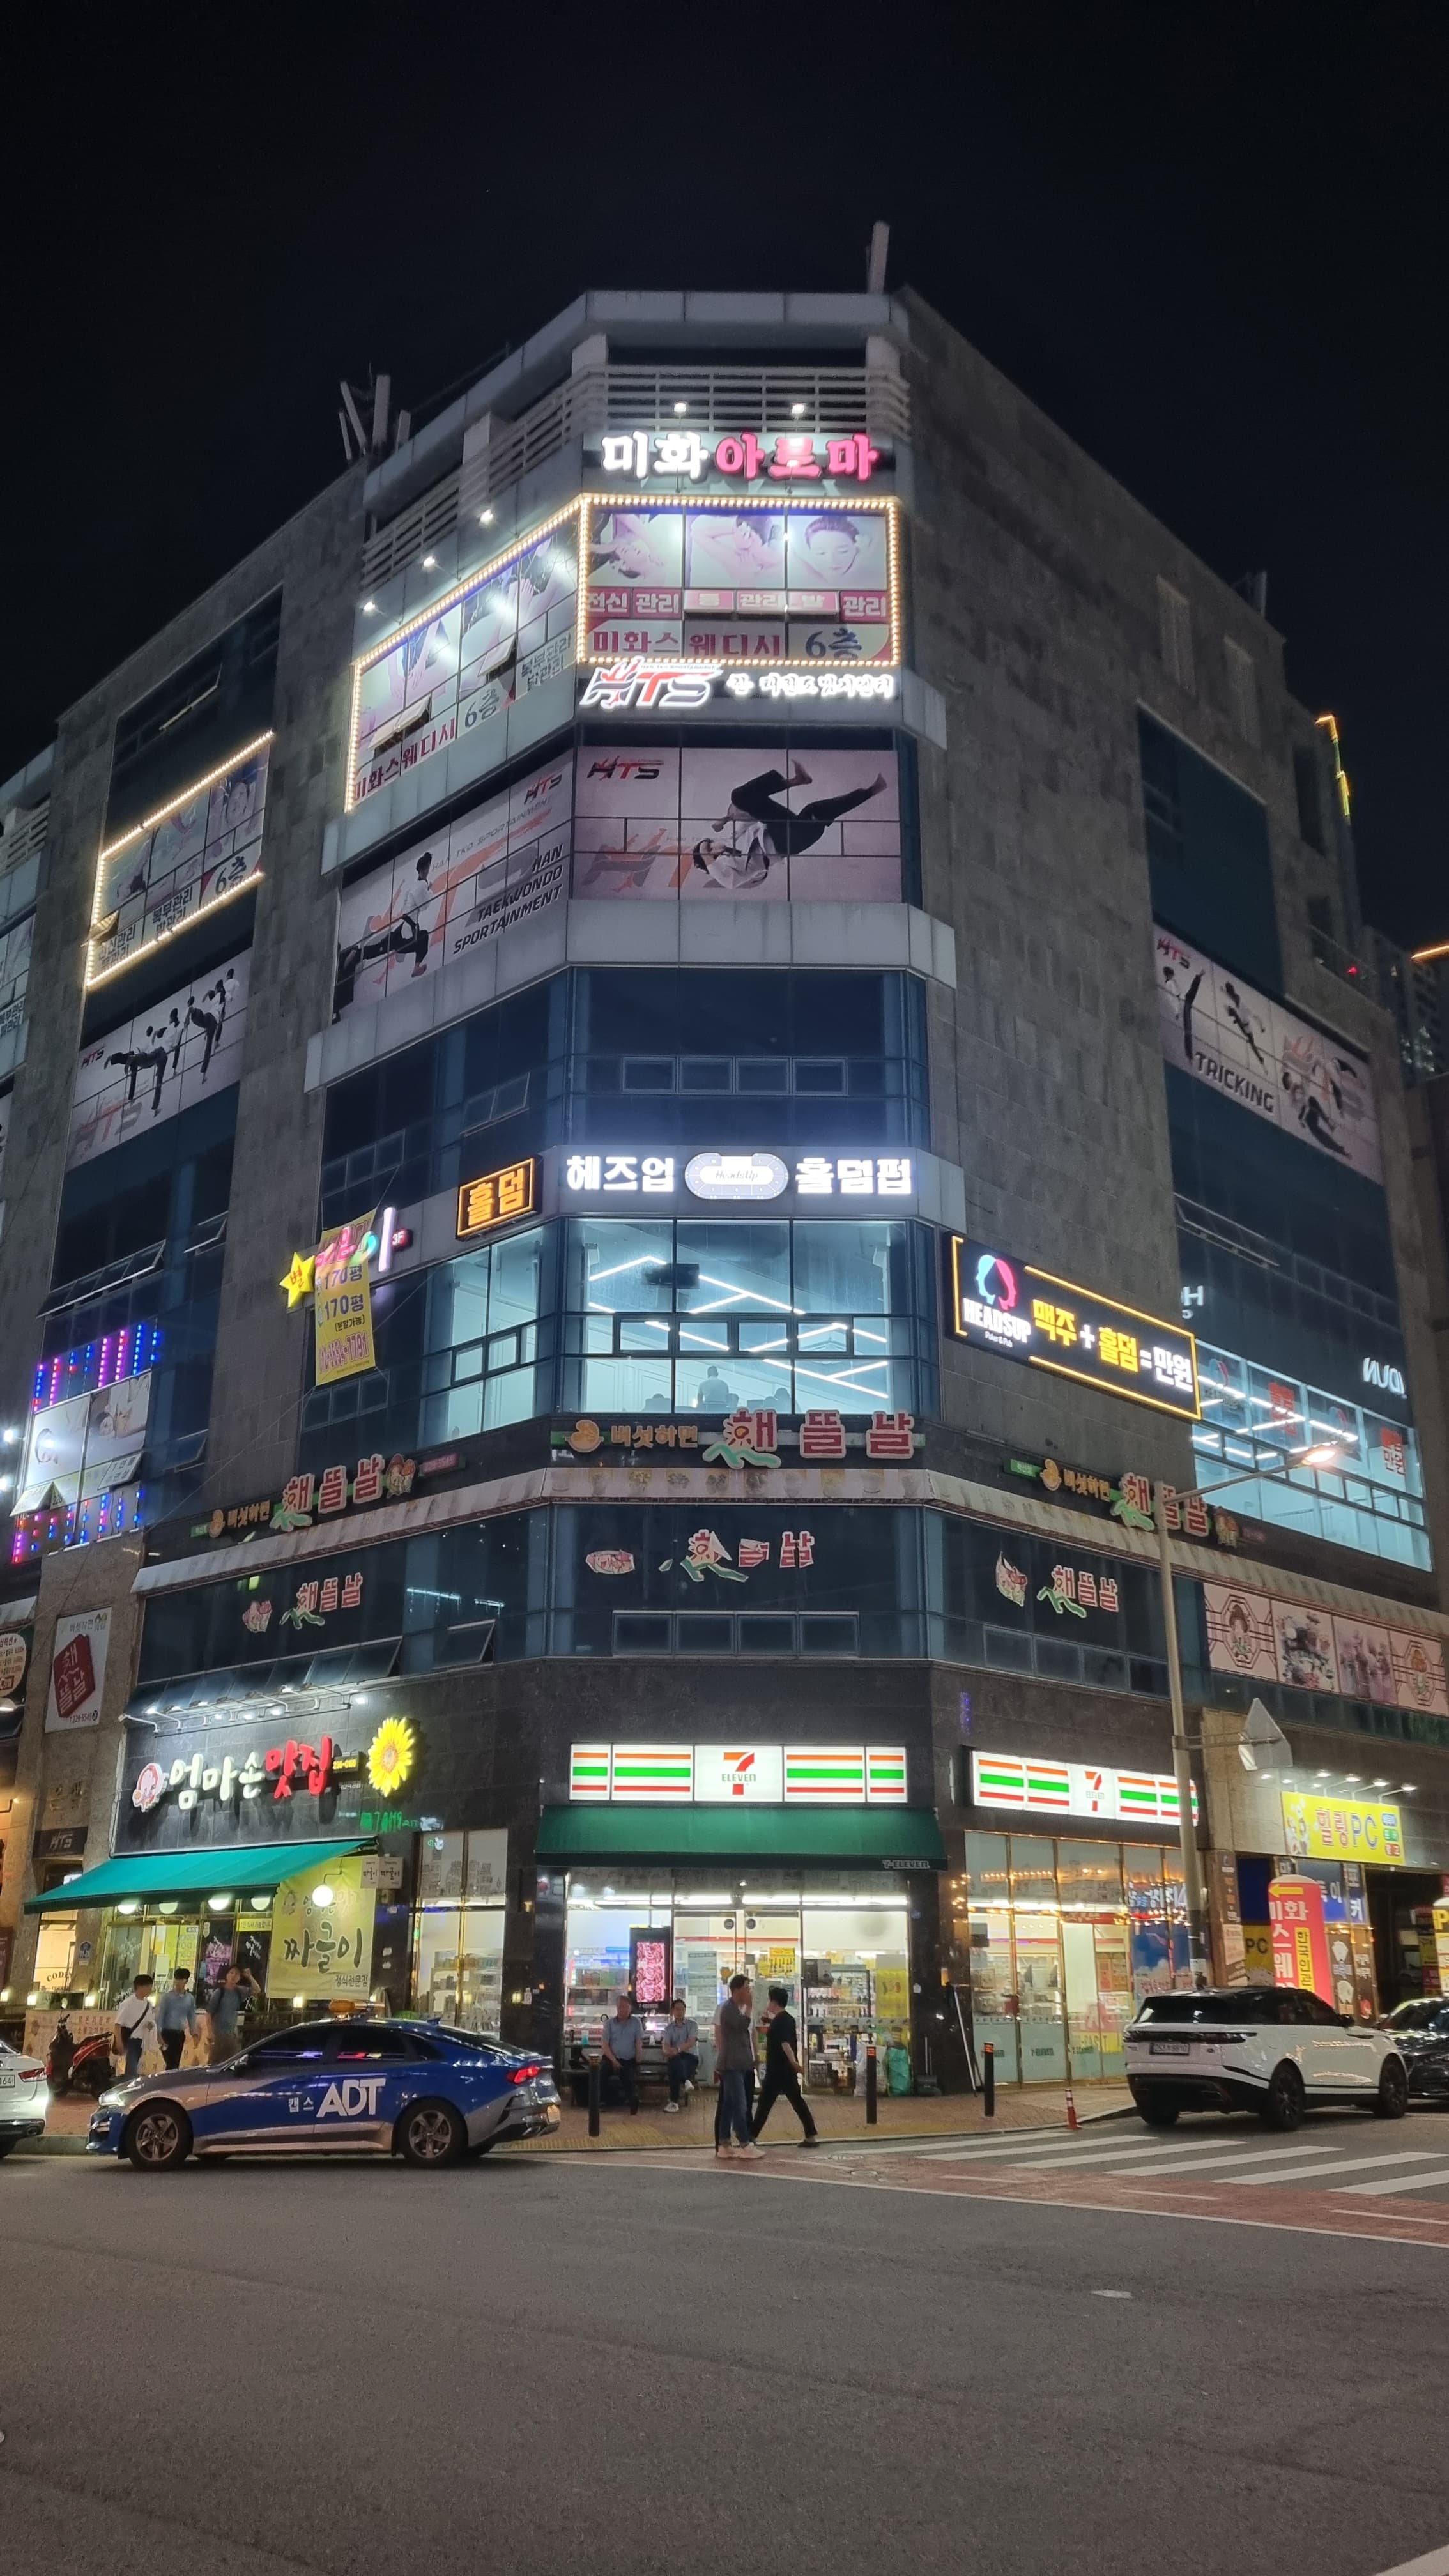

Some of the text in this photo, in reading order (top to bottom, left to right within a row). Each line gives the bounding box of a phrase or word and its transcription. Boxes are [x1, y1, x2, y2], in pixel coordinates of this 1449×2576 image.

[602, 432, 709, 480] 미화
[587, 590, 679, 615] 전신 관리
[739, 593, 784, 608] 관리
[843, 594, 887, 618] 관리
[594, 627, 862, 661] 미화스웨디시 6층
[464, 687, 500, 728] 6층
[586, 756, 664, 781] HTS
[531, 843, 564, 875] HAN
[477, 864, 564, 924] TAEKWONDO
[453, 884, 564, 954] SPORTAINMENT
[1193, 1051, 1276, 1114] TRICKING
[795, 1157, 912, 1195] 홀덤펍
[467, 1167, 525, 1227] 홀덤
[392, 1230, 405, 1246] 3F
[325, 1294, 364, 1321] 170평
[962, 1298, 1031, 1344] HEADSUP
[1032, 1298, 1077, 1346] 맥주
[1098, 1326, 1139, 1373] 홀덤
[1153, 1346, 1193, 1393] 만원
[610, 1407, 915, 1460] 버섯하면 해뜰날
[282, 1453, 385, 1515] 해뜰날
[296, 1572, 364, 1613] 해뜰날
[1052, 1564, 1119, 1613] 해뜰날
[169, 1735, 333, 1811] 엄마손 맛집
[283, 1919, 363, 1974] 짜글이
[1246, 1938, 1268, 1954] PC
[288, 2097, 314, 2113] 캡스
[316, 2078, 387, 2118] ADT
